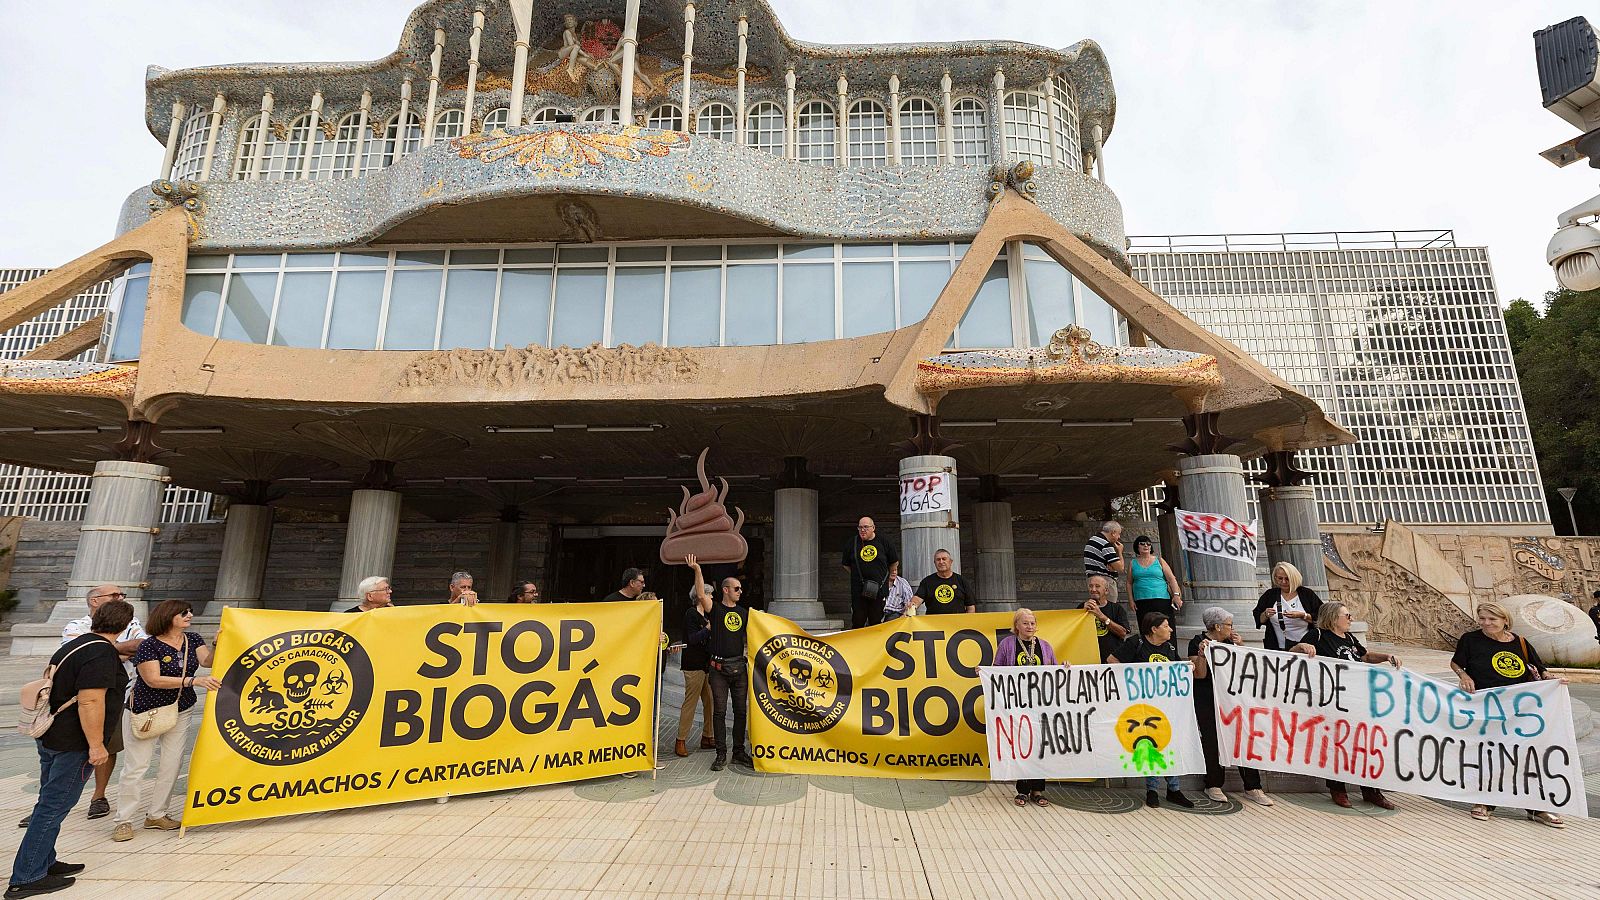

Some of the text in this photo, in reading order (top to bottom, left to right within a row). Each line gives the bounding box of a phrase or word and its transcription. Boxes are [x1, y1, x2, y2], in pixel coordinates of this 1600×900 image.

[240, 631, 354, 669] STOP BIOGÁS
[266, 649, 339, 671] LOS CAMACHOS
[416, 619, 596, 679] STOP
[762, 636, 835, 660] STOP BIOGÁS
[778, 649, 825, 665] LOS CAMACHOS
[990, 667, 1120, 710] MACROPLANTA
[1209, 645, 1313, 707] PLANTA
[1319, 661, 1349, 712] DE
[271, 710, 317, 731] SOS
[379, 659, 642, 748] BIOGÁS
[758, 692, 799, 730] CARTAGENA
[803, 721, 821, 731] MAR
[821, 701, 846, 729] MENOR
[788, 694, 816, 712] SOS
[223, 718, 282, 761] CARTAGENA
[291, 743, 320, 760] MAR
[320, 709, 361, 749] MENOR
[995, 706, 1096, 761] NO AQUÍ
[192, 742, 648, 809] LOS CAMACHOS / CARTAGENA / MAR MENOR
[778, 745, 869, 766] CAMACHOS
[873, 753, 881, 767] /
[884, 752, 984, 767] CARTAGENA
